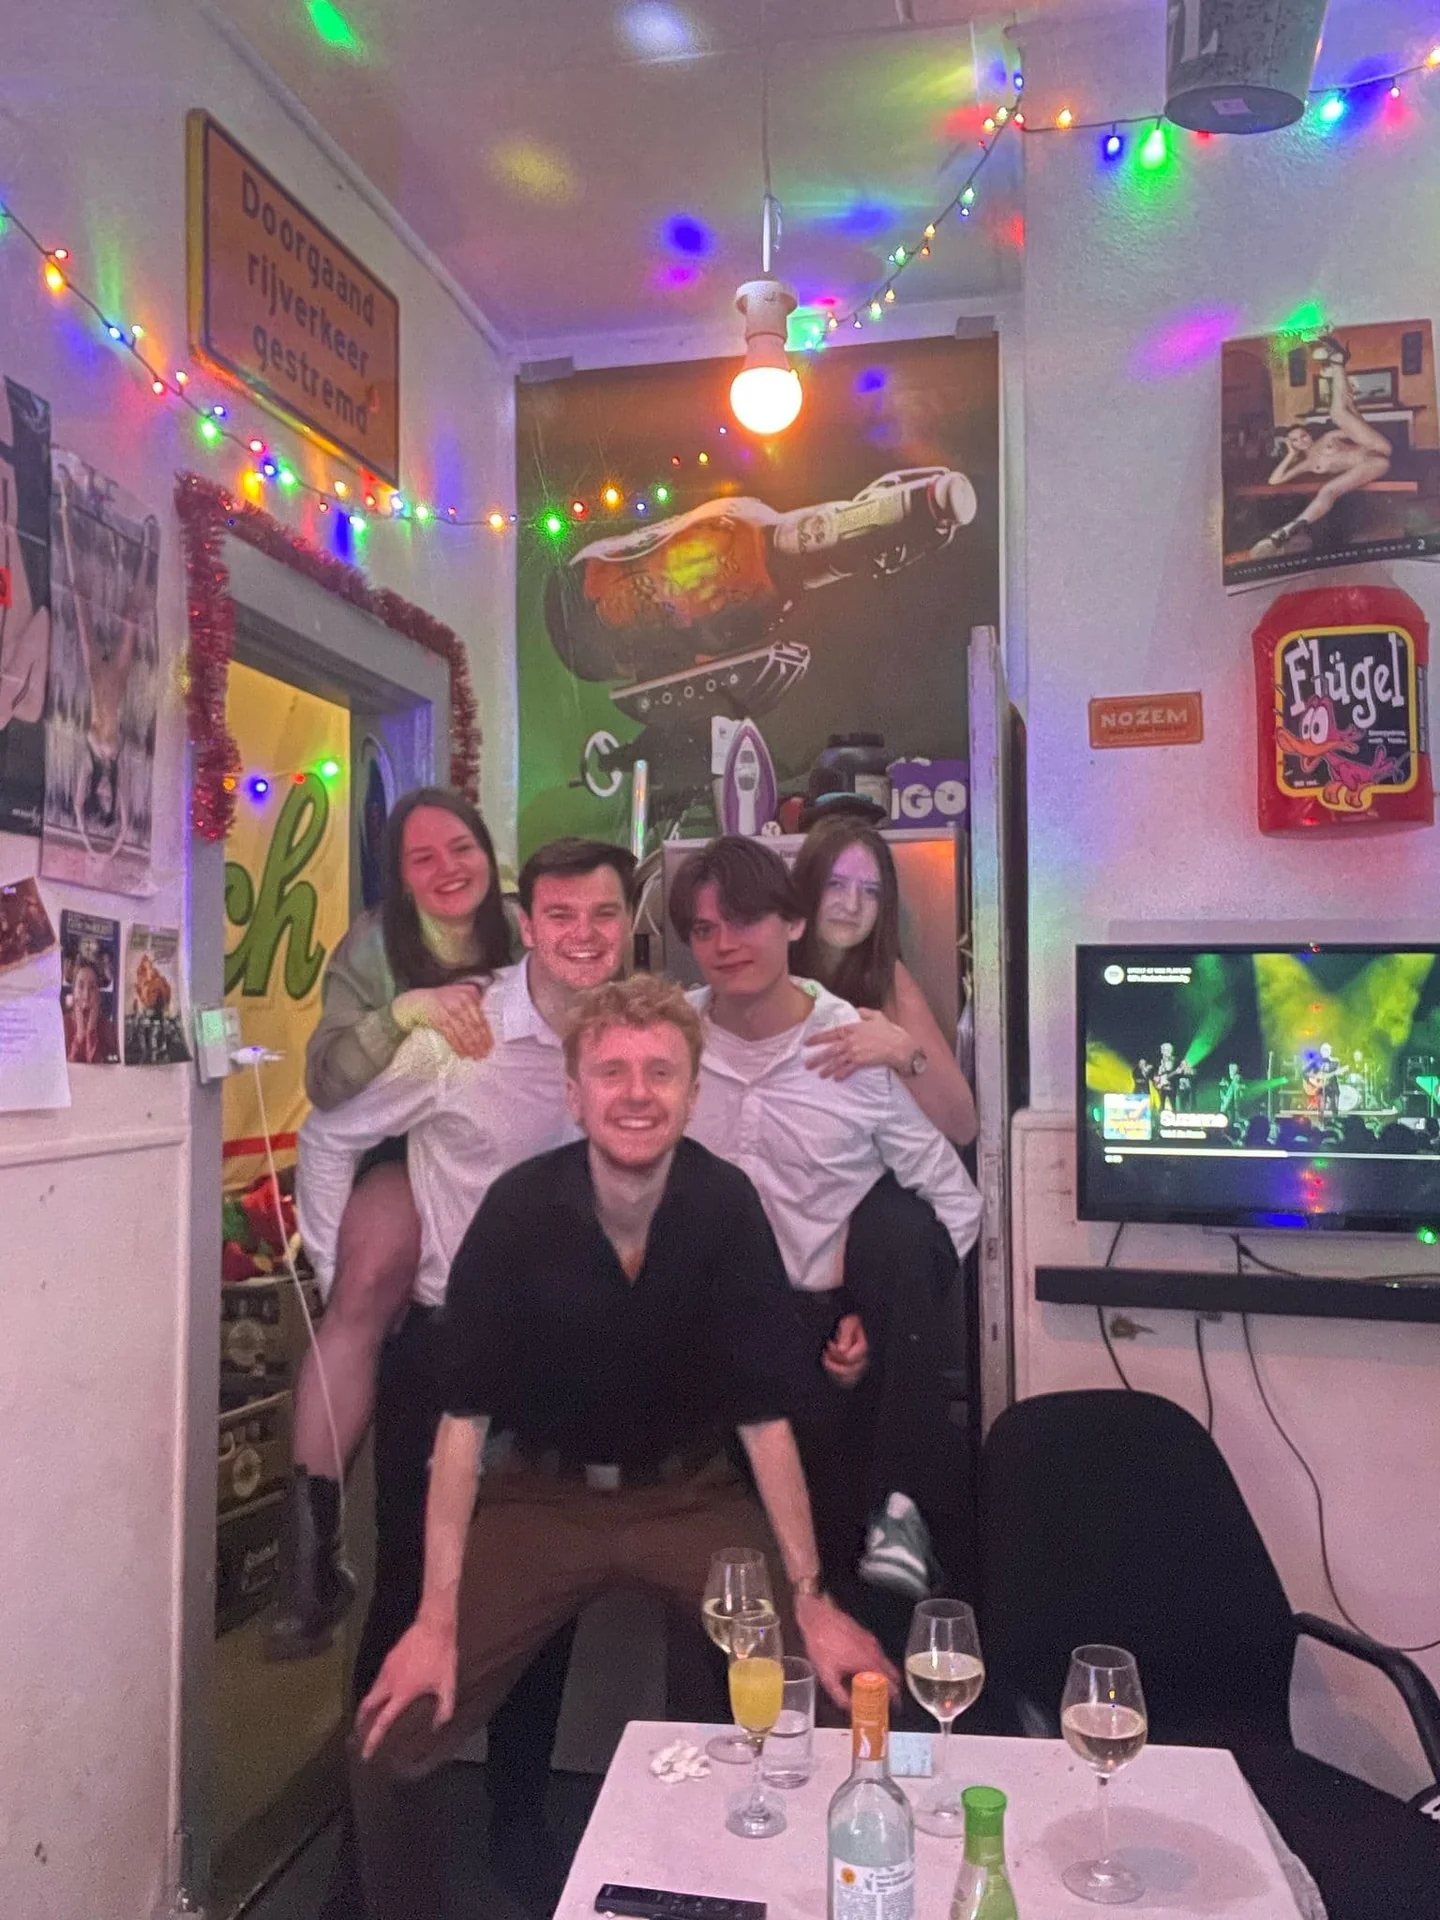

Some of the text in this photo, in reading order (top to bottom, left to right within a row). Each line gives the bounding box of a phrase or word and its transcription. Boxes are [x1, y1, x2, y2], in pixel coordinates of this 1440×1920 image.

[241, 169, 375, 328] Doorgaand
[249, 252, 370, 379] rijverkeer
[253, 324, 369, 436] gestremd
[1100, 706, 1188, 728] NOZEM
[1284, 632, 1405, 729] Flügel
